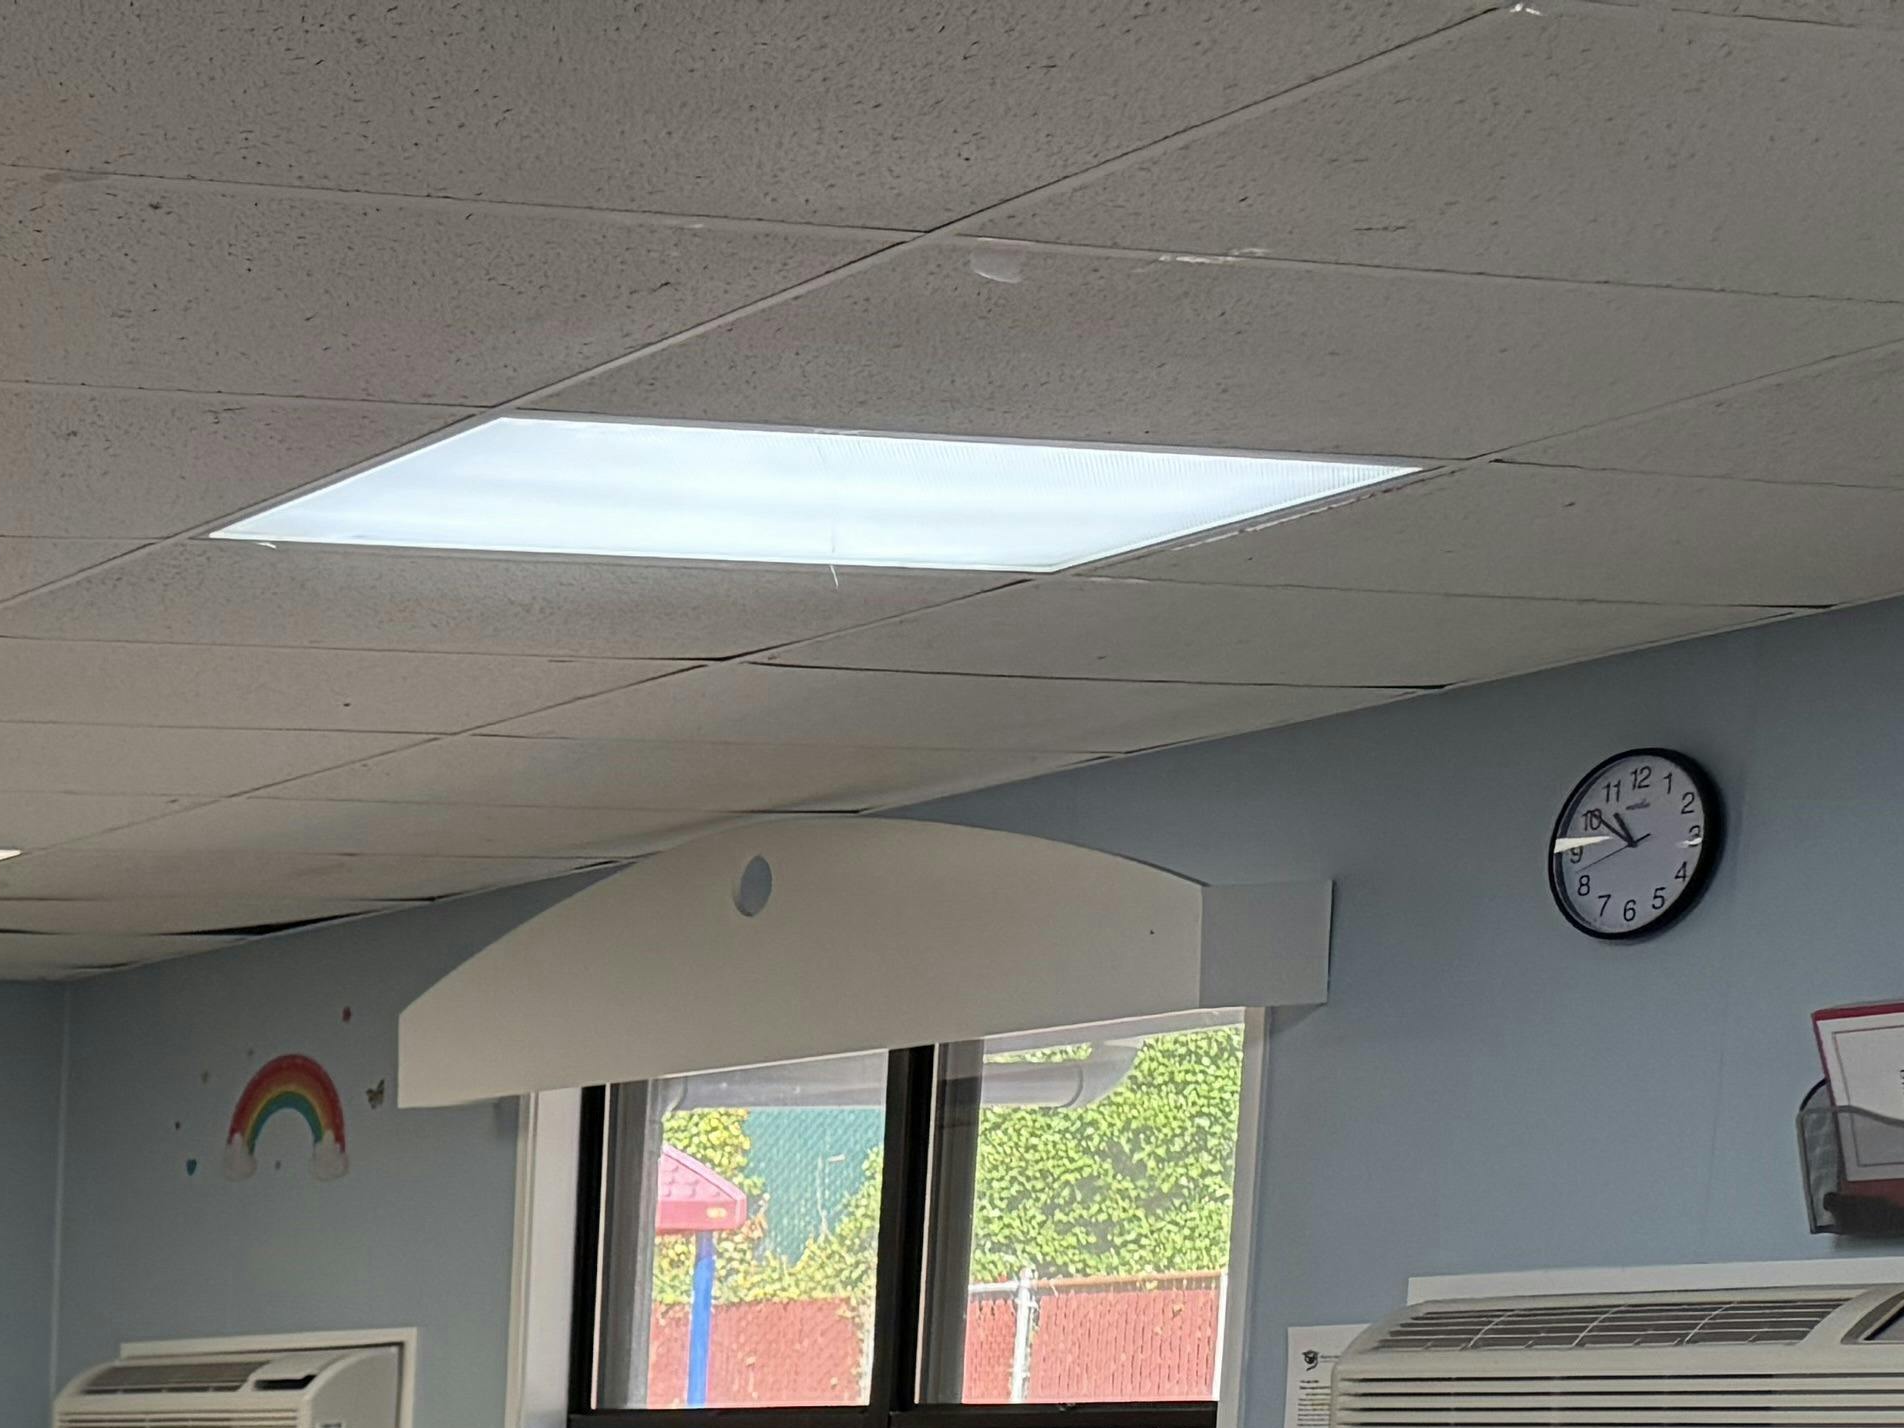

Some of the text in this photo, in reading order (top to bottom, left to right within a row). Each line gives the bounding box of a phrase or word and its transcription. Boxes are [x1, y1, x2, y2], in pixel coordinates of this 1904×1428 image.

[1630, 766, 1652, 790] 12
[1663, 772, 1673, 794] 1
[1603, 780, 1622, 803] 11
[1680, 791, 1695, 815] 2
[1582, 808, 1602, 832] 10
[1687, 825, 1703, 848] 3
[1674, 861, 1688, 882] 4
[1577, 875, 1591, 896] 8
[1597, 894, 1612, 917] 7
[1651, 887, 1667, 910] 5
[1623, 899, 1637, 922] 6
